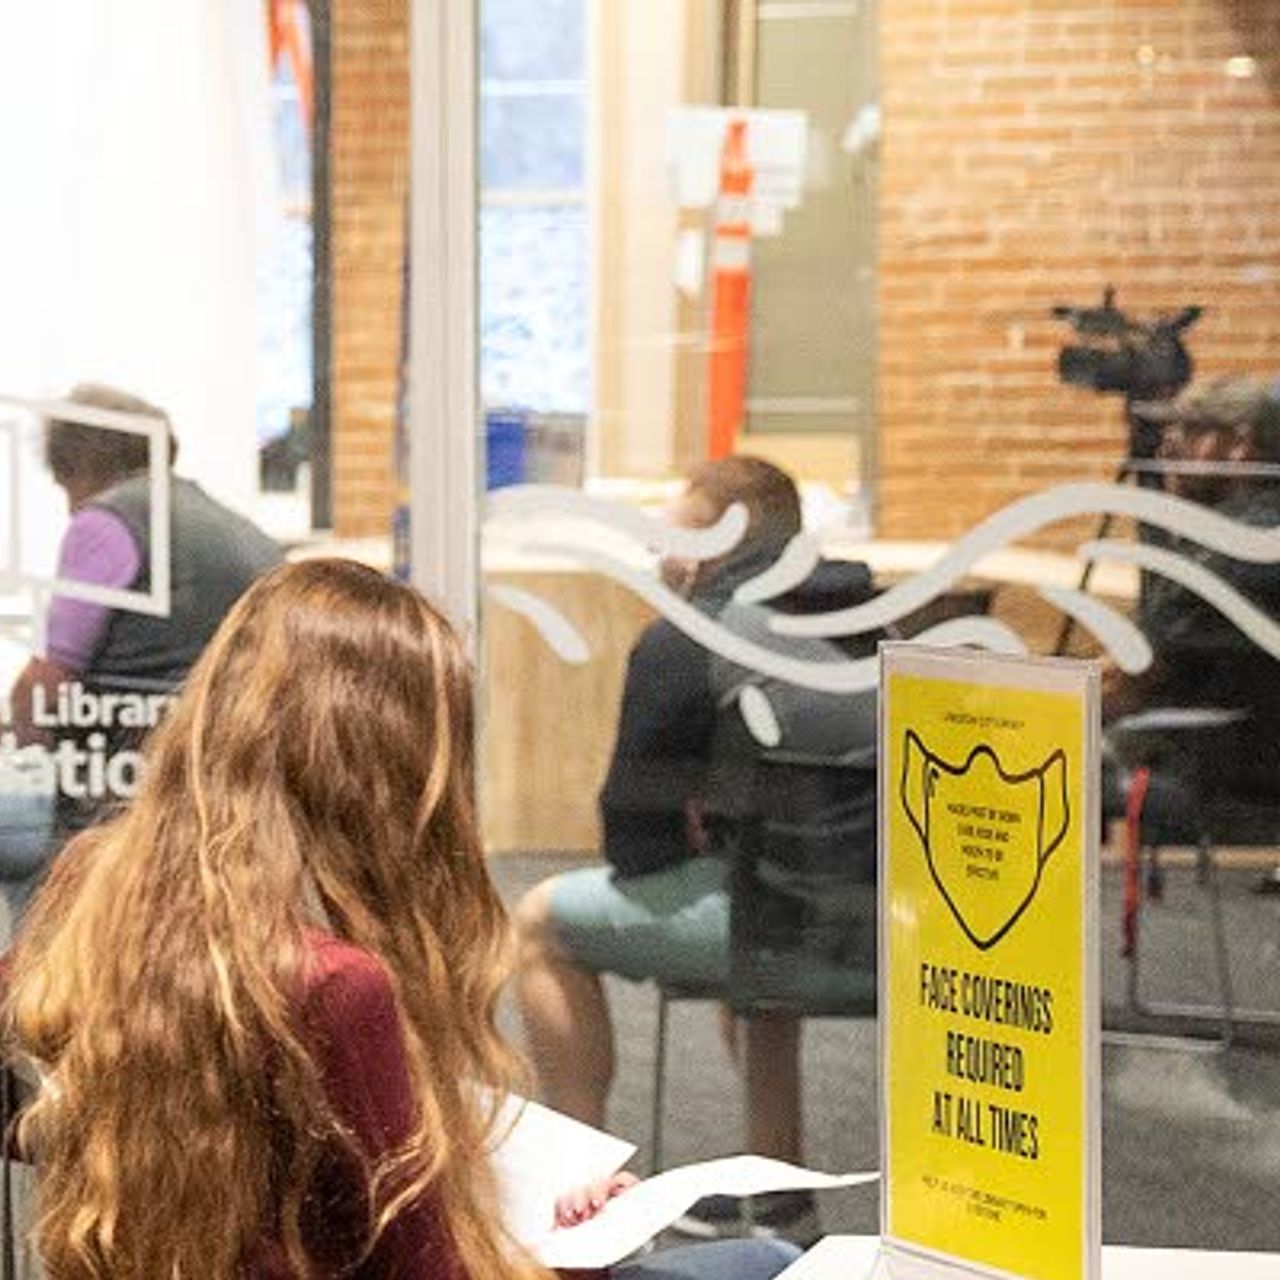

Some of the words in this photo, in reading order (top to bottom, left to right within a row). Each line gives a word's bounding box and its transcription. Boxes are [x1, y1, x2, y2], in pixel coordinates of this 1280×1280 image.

[920, 962, 958, 1013] FACE
[961, 972, 1053, 1034] COVERINGS
[947, 1030, 1024, 1092] REQUIRED
[933, 1090, 952, 1137] AT
[957, 1096, 985, 1147] ALL
[988, 1104, 1039, 1160] TIMES
